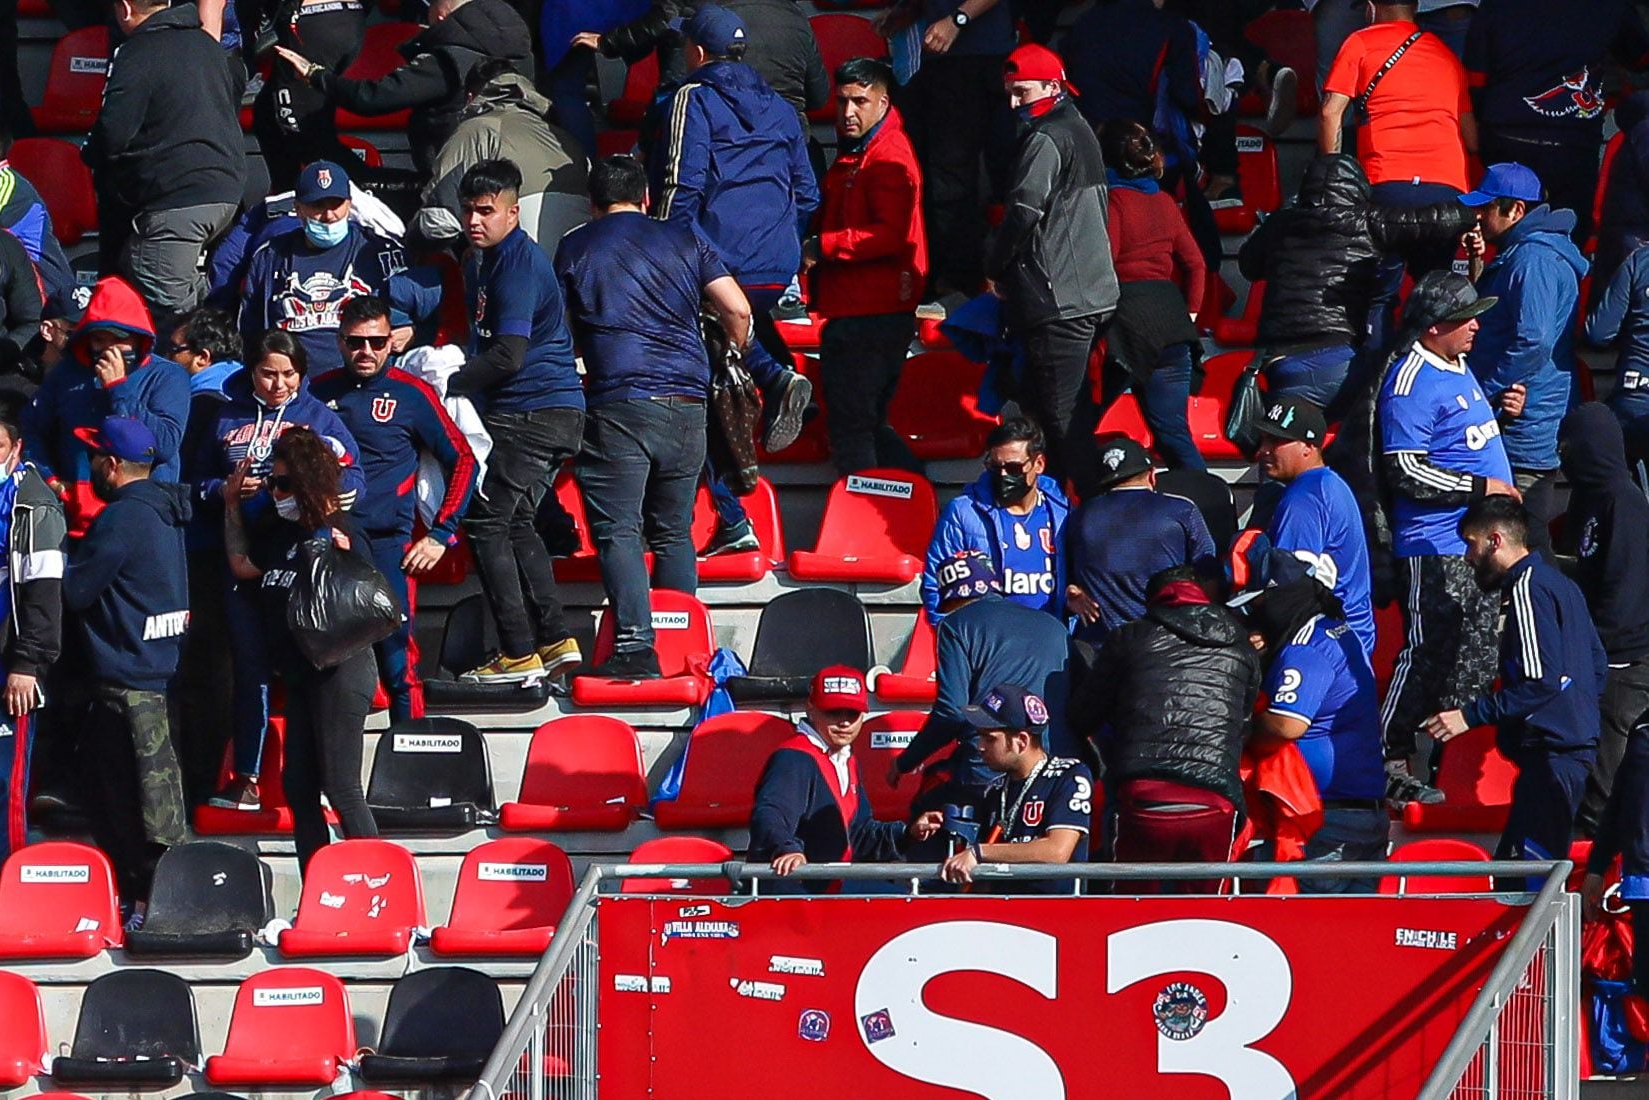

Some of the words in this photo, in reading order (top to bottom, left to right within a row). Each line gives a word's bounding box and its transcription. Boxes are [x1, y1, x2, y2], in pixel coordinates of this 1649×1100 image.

[859, 481, 911, 496] HABILITADO
[409, 738, 460, 748] HABILITADO
[35, 871, 87, 881] HABILITADO
[493, 867, 545, 878] HABILITADO
[269, 991, 321, 1002] HABILITADO
